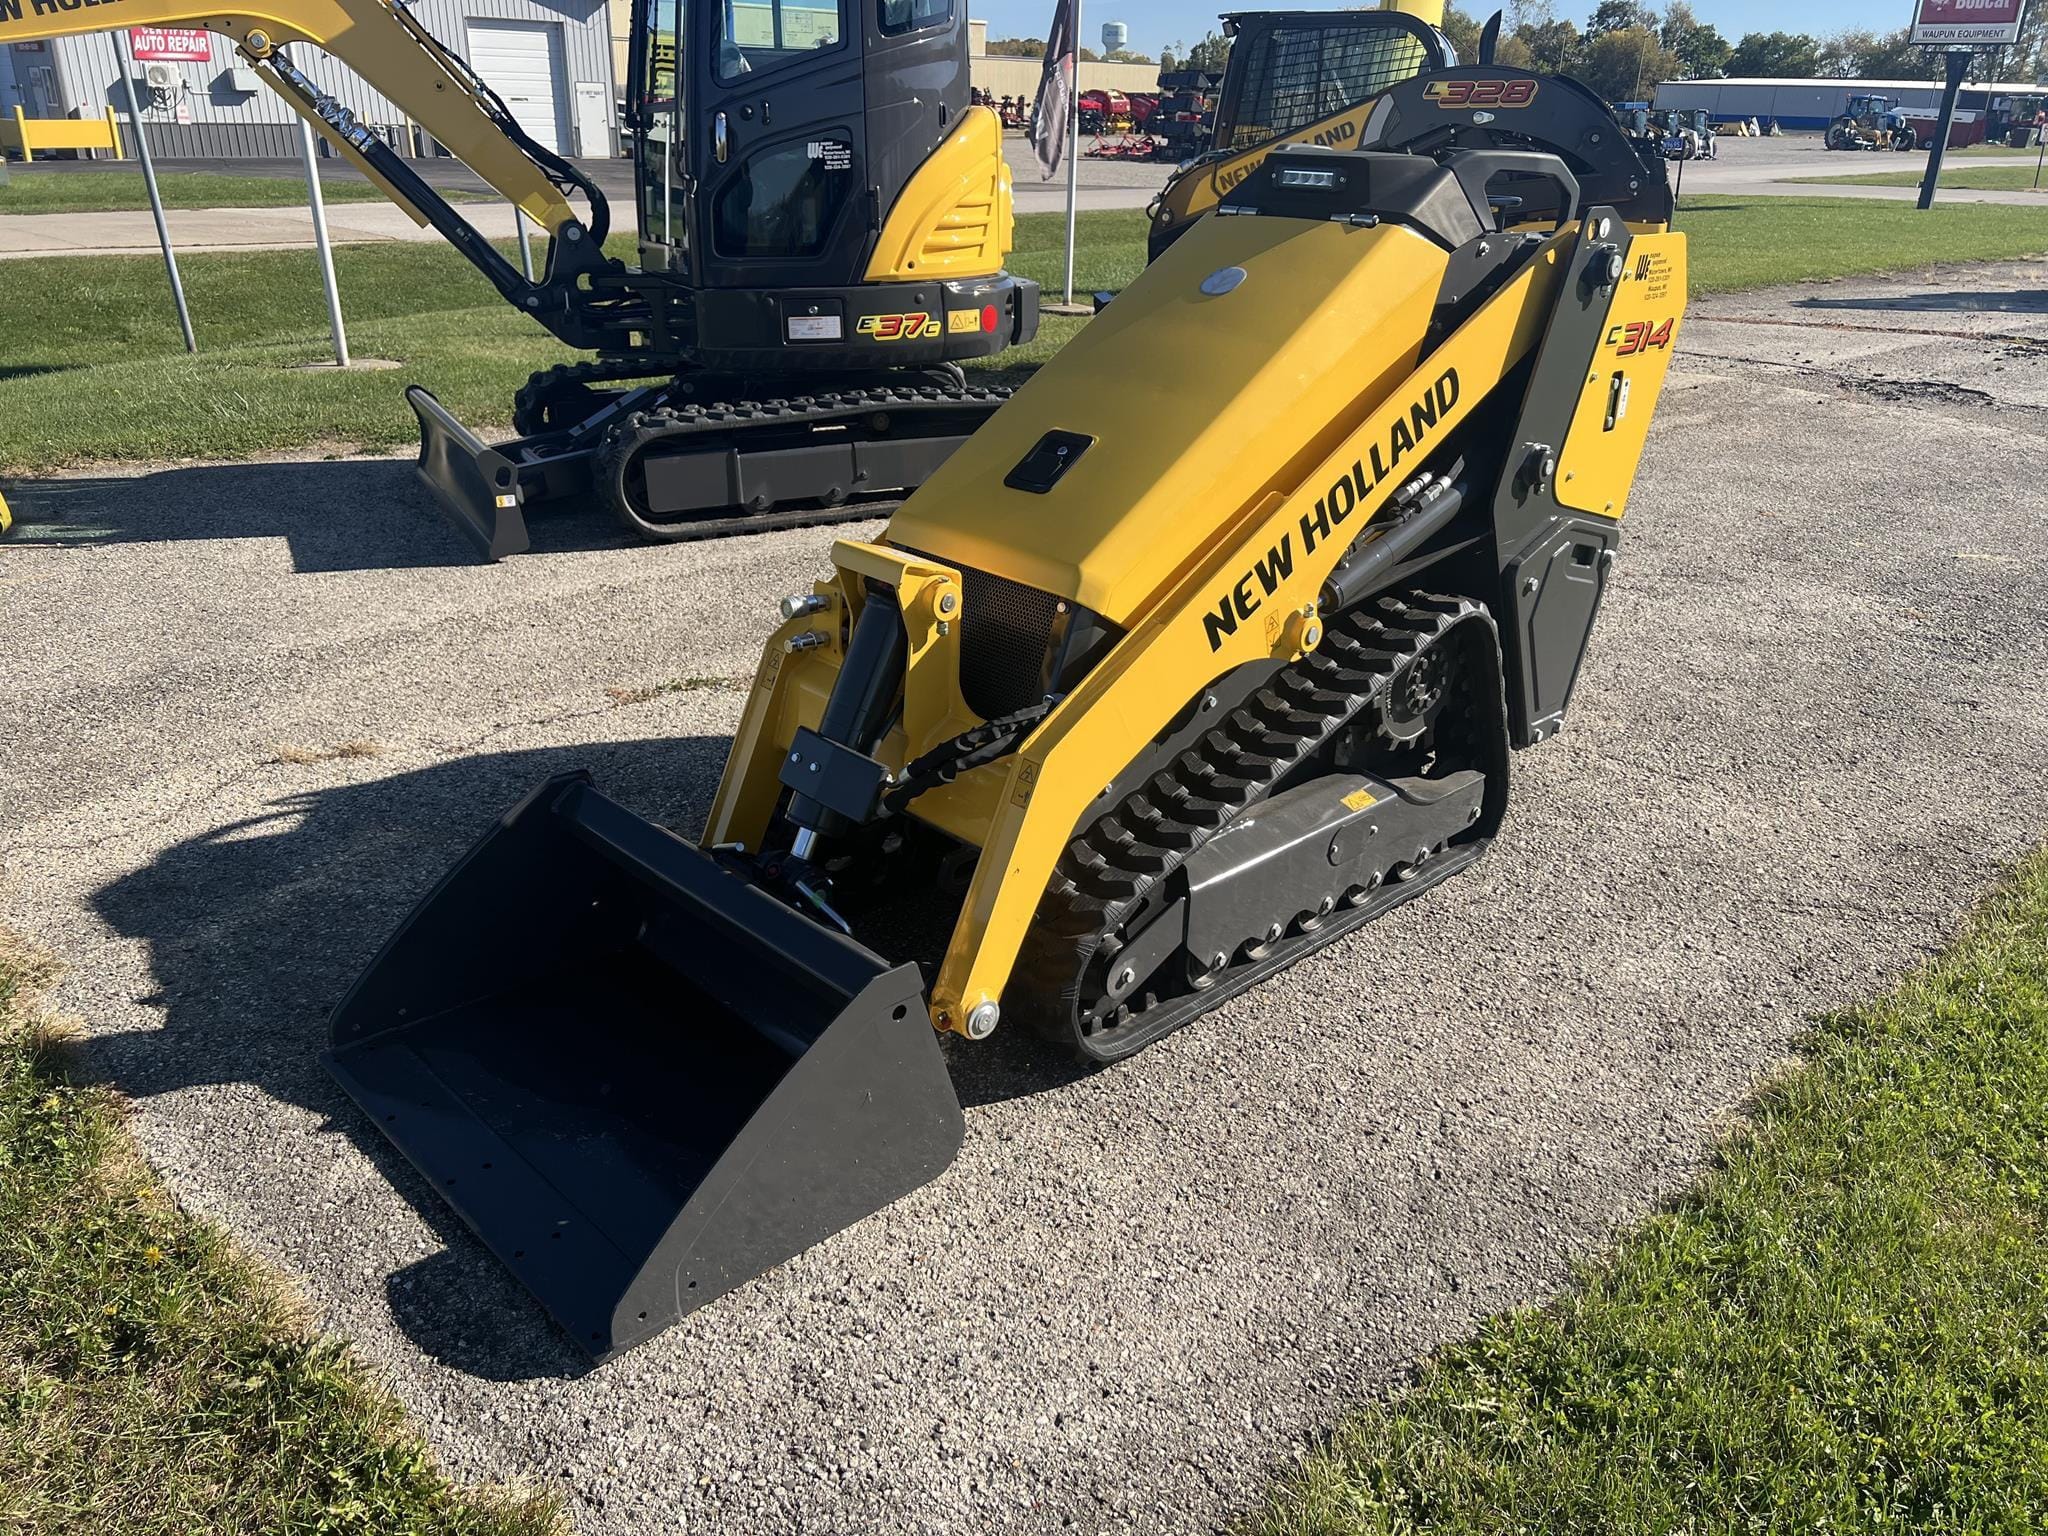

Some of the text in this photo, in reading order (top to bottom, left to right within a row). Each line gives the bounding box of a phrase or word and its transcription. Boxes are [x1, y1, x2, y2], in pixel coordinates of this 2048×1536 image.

[134, 35, 207, 52] AUTO REPAIR
[1922, 29, 2005, 38] WAUPUN EQUIPMENT
[1423, 80, 1539, 108] L328
[1605, 317, 1674, 357] C314
[1203, 367, 1460, 653] NEW HOLLAND
